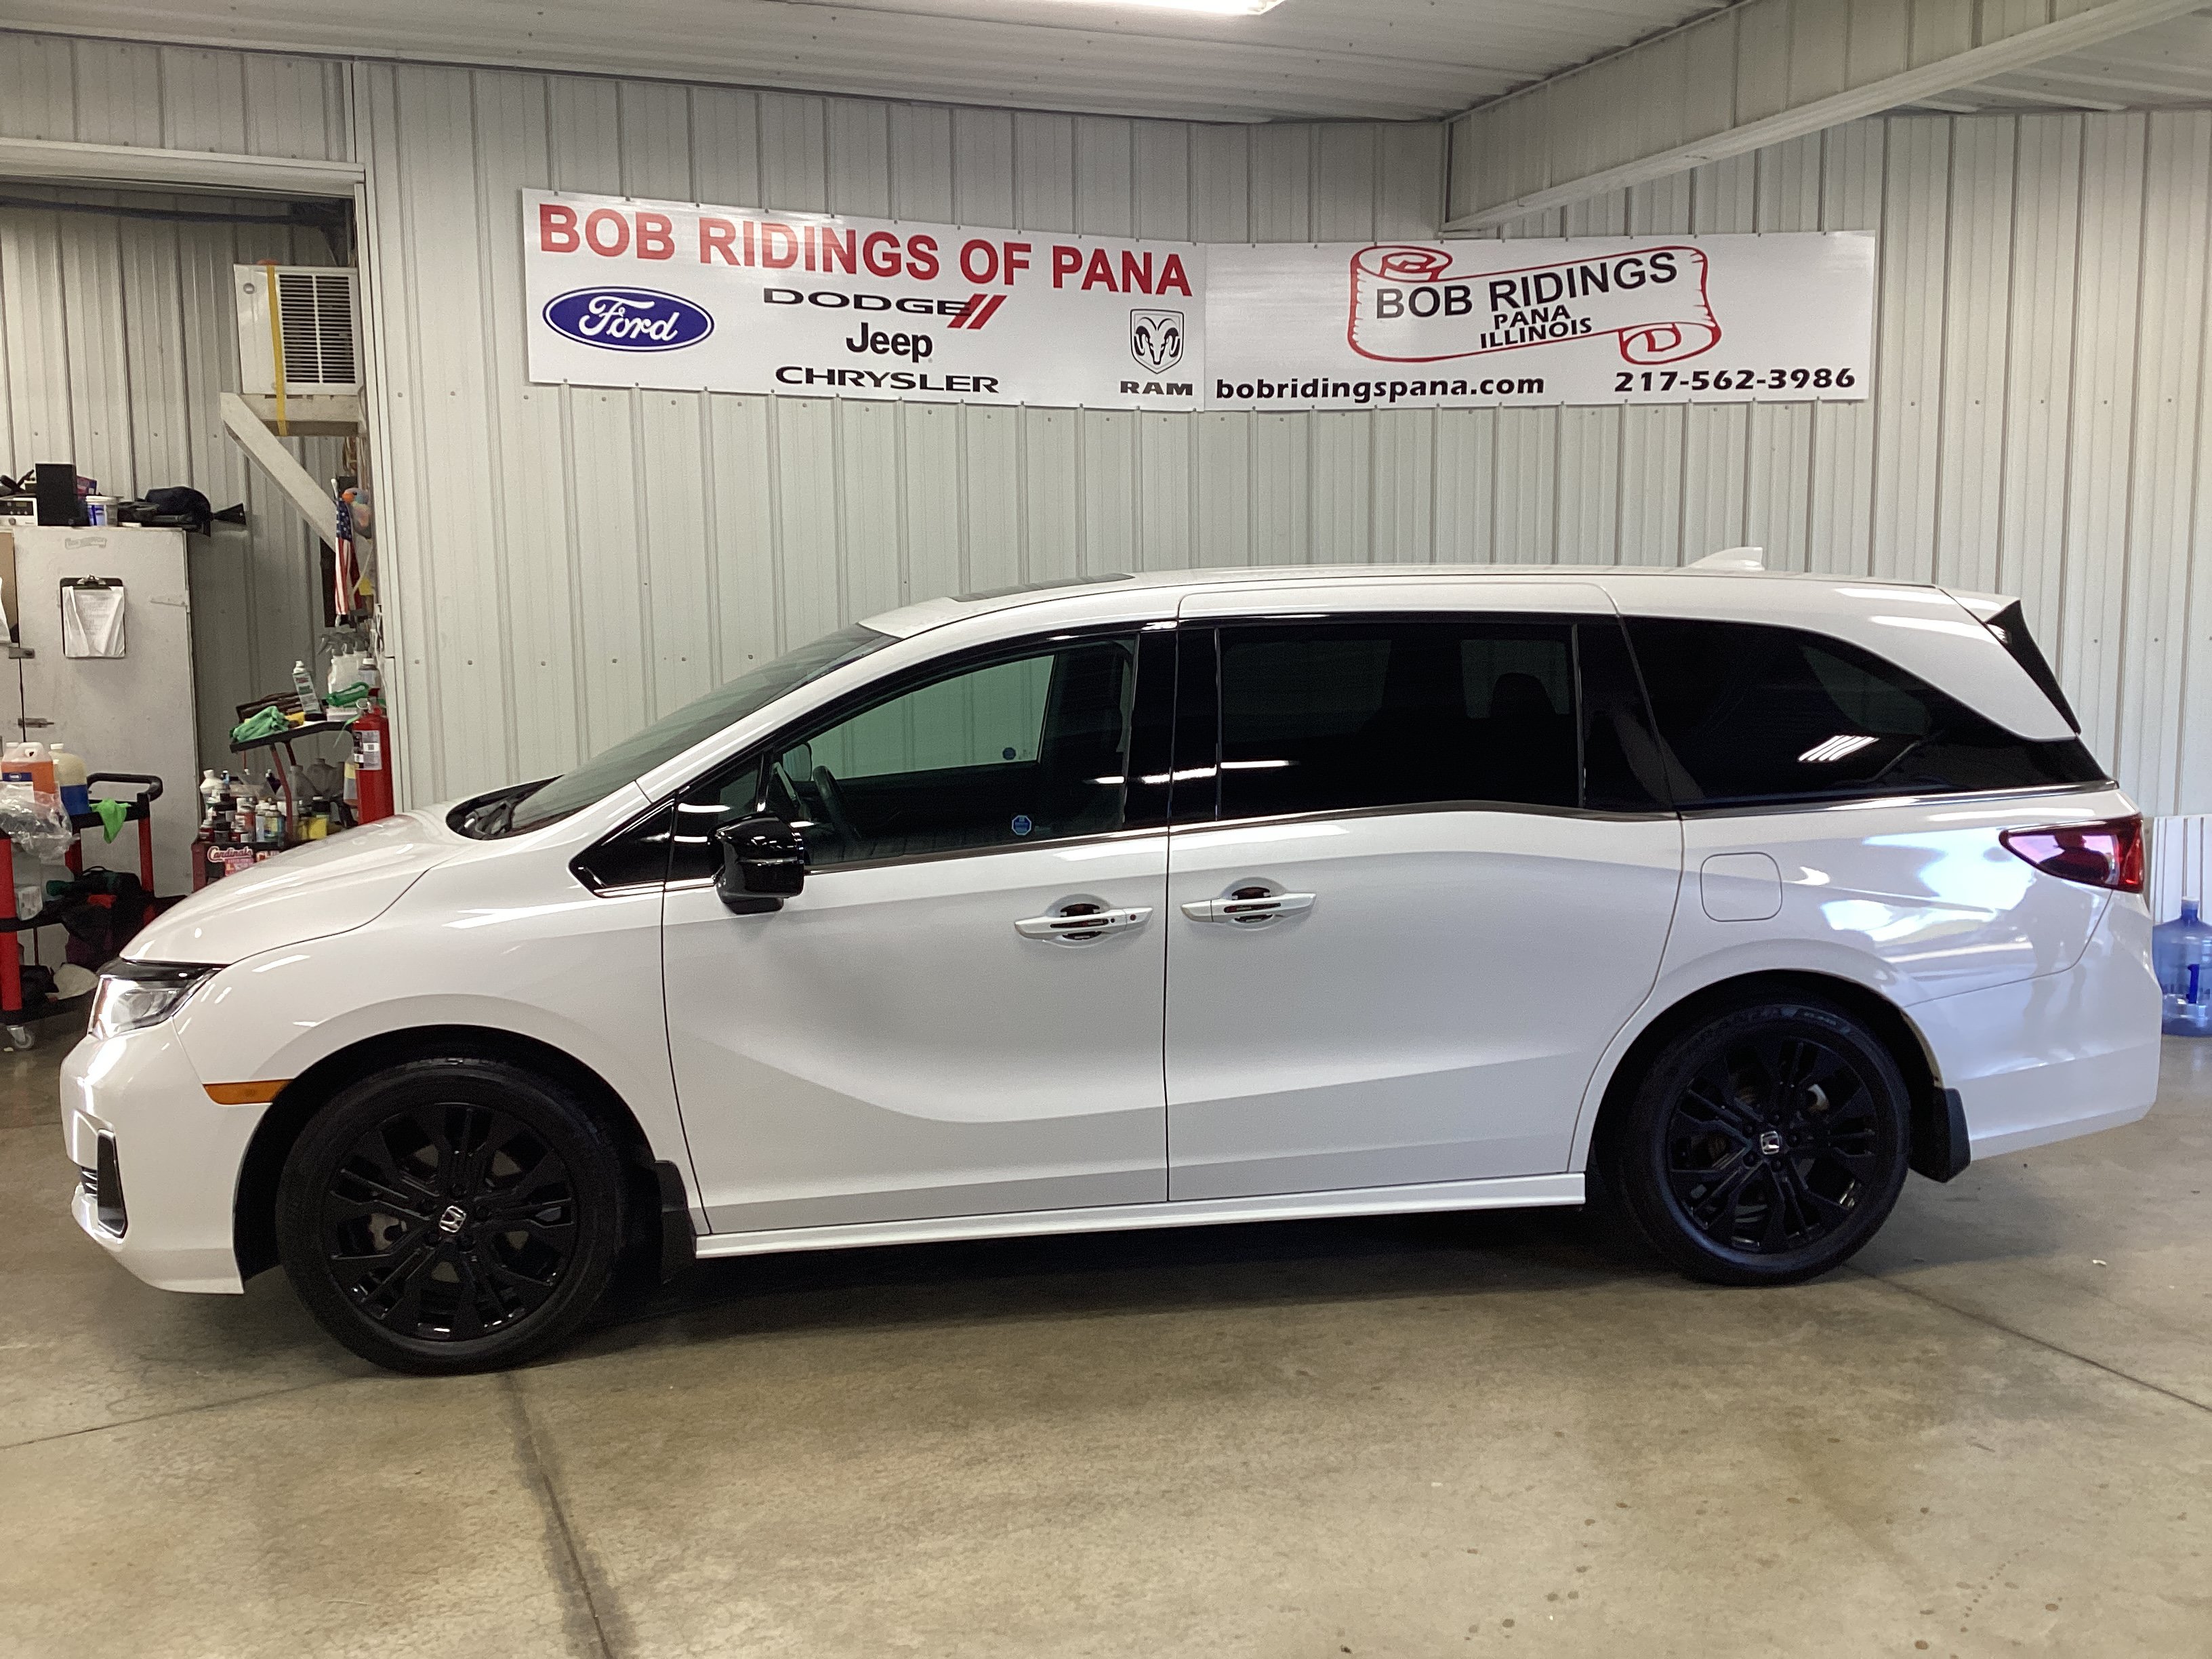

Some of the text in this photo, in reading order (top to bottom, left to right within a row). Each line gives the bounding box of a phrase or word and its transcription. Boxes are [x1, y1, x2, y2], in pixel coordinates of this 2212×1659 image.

[539, 203, 1193, 297] BOB RIDINGS OF PANA
[1376, 252, 1677, 319] BOB RIDINGS
[764, 288, 972, 316] DODGE
[578, 295, 678, 341] Ford
[1494, 304, 1571, 330] PANA
[846, 322, 933, 363] Jeep
[1480, 317, 1593, 349] ILLINOIS
[775, 366, 1000, 393] CHRYSLER
[1120, 381, 1193, 396] RAM
[1216, 377, 1544, 403] bobridingspana.com
[1614, 368, 1856, 392] 217-562-3986
